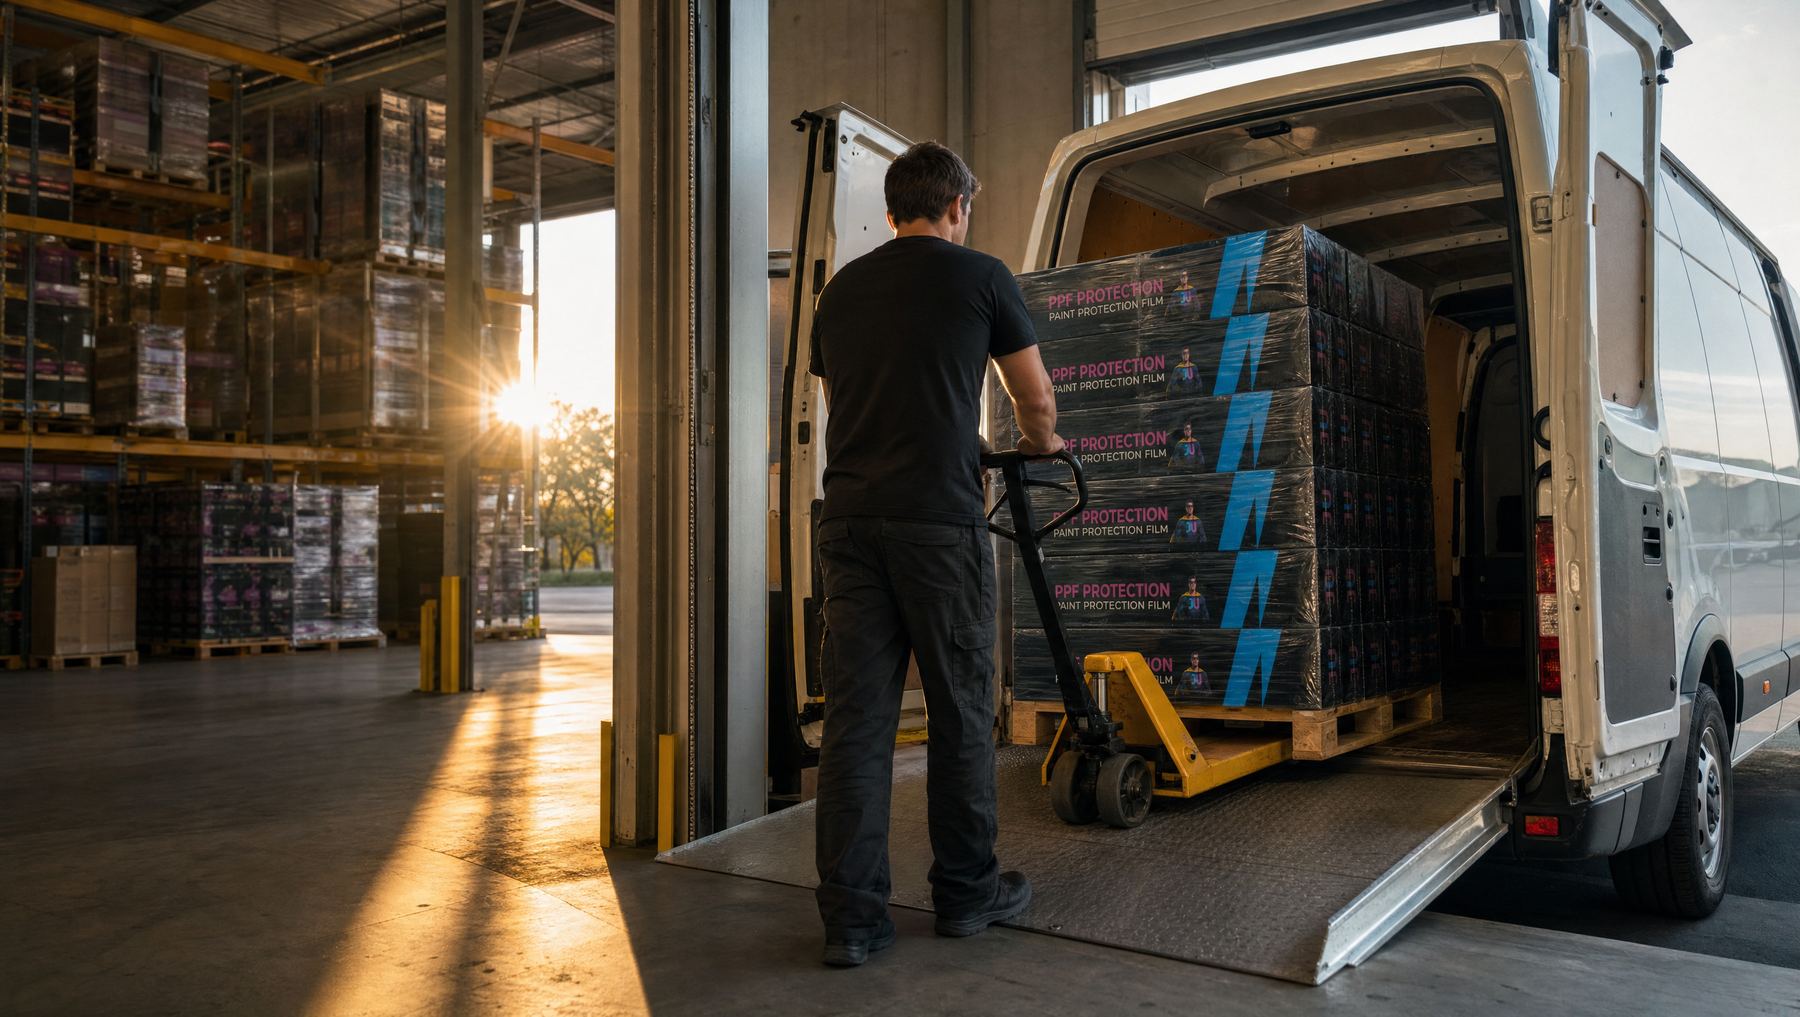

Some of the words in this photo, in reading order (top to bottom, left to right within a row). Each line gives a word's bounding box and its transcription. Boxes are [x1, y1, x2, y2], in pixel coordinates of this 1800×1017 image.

[1048, 293, 1074, 310] PPF
[1077, 278, 1164, 305] PROTECTION
[1049, 309, 1076, 321] PAINT
[1078, 300, 1139, 318] PROTECTION
[1141, 296, 1164, 308] FILM
[1052, 366, 1076, 382] PPF
[1079, 354, 1166, 379] PROTECTION
[1052, 382, 1078, 394] PAINT
[1080, 375, 1140, 391] PROTECTION
[1143, 373, 1165, 384] FILM
[1063, 438, 1078, 453] PF
[1081, 430, 1167, 452] PROTECTION
[1081, 450, 1142, 464] PROTECTION
[1145, 449, 1167, 459] FILM
[1082, 506, 1169, 525] PROTECTION
[1053, 527, 1080, 538] PAINT
[1082, 525, 1143, 537] PROTECTION
[1146, 524, 1169, 534] FILM
[1055, 584, 1079, 598] PPF
[1083, 582, 1171, 598] PROTECTION
[1083, 600, 1145, 610] PROTECTION
[1148, 600, 1171, 610] FILM
